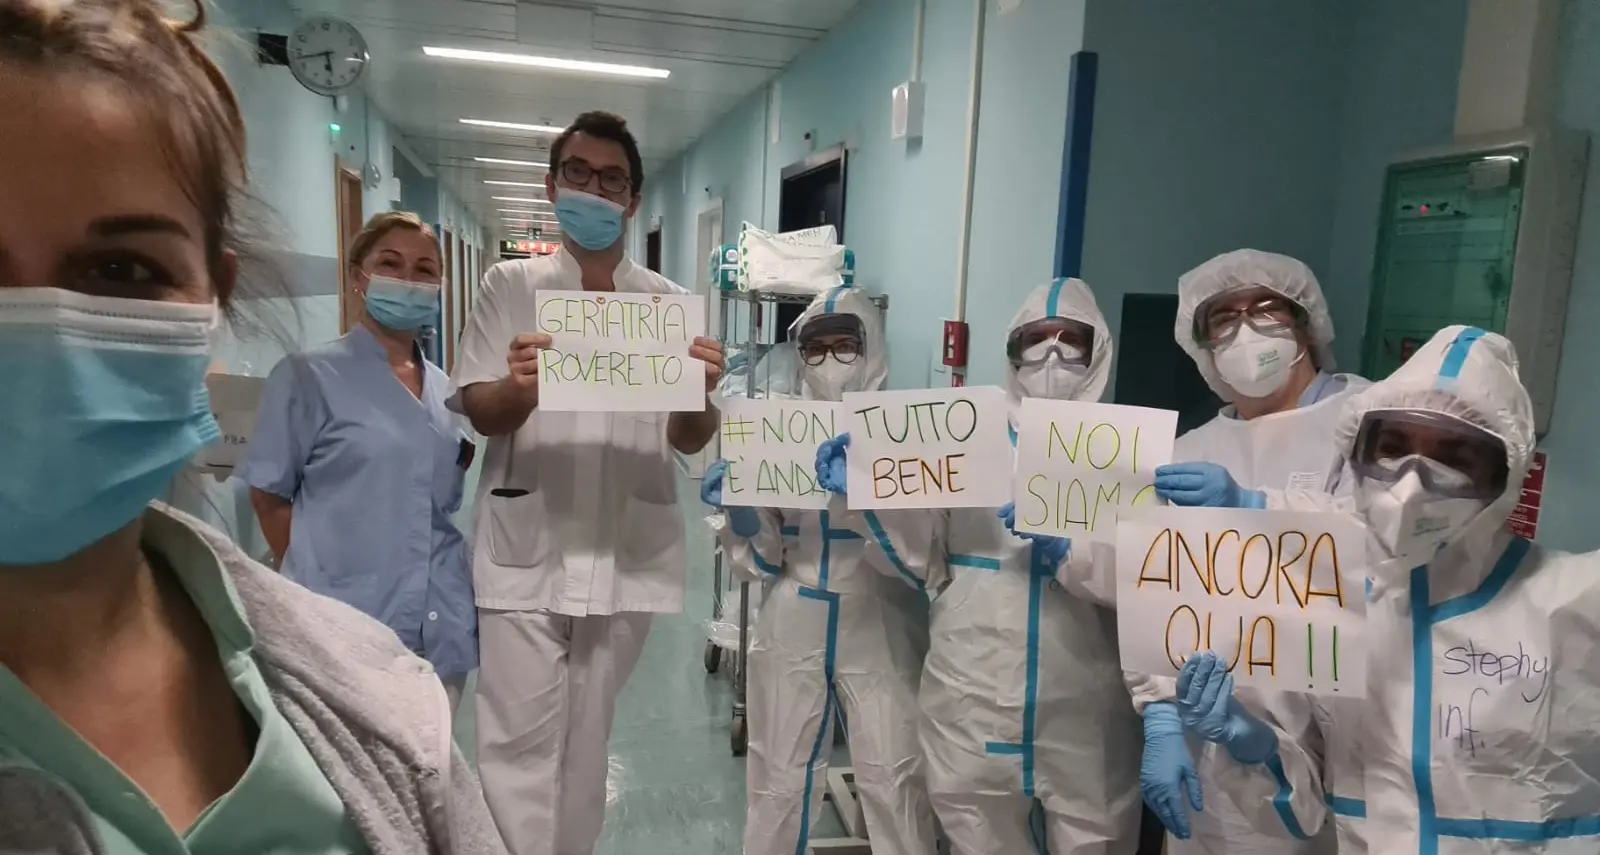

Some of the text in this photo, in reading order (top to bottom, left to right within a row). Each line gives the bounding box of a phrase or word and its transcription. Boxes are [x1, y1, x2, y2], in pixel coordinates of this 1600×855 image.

[540, 348, 683, 386] ROVERETO
[854, 399, 977, 444] TUTTO
[1048, 420, 1140, 474] NOI
[872, 453, 966, 499] BENE
[1023, 474, 1157, 532] SIAM
[1137, 527, 1345, 609] ANCORA
[1165, 604, 1277, 677] QUA
